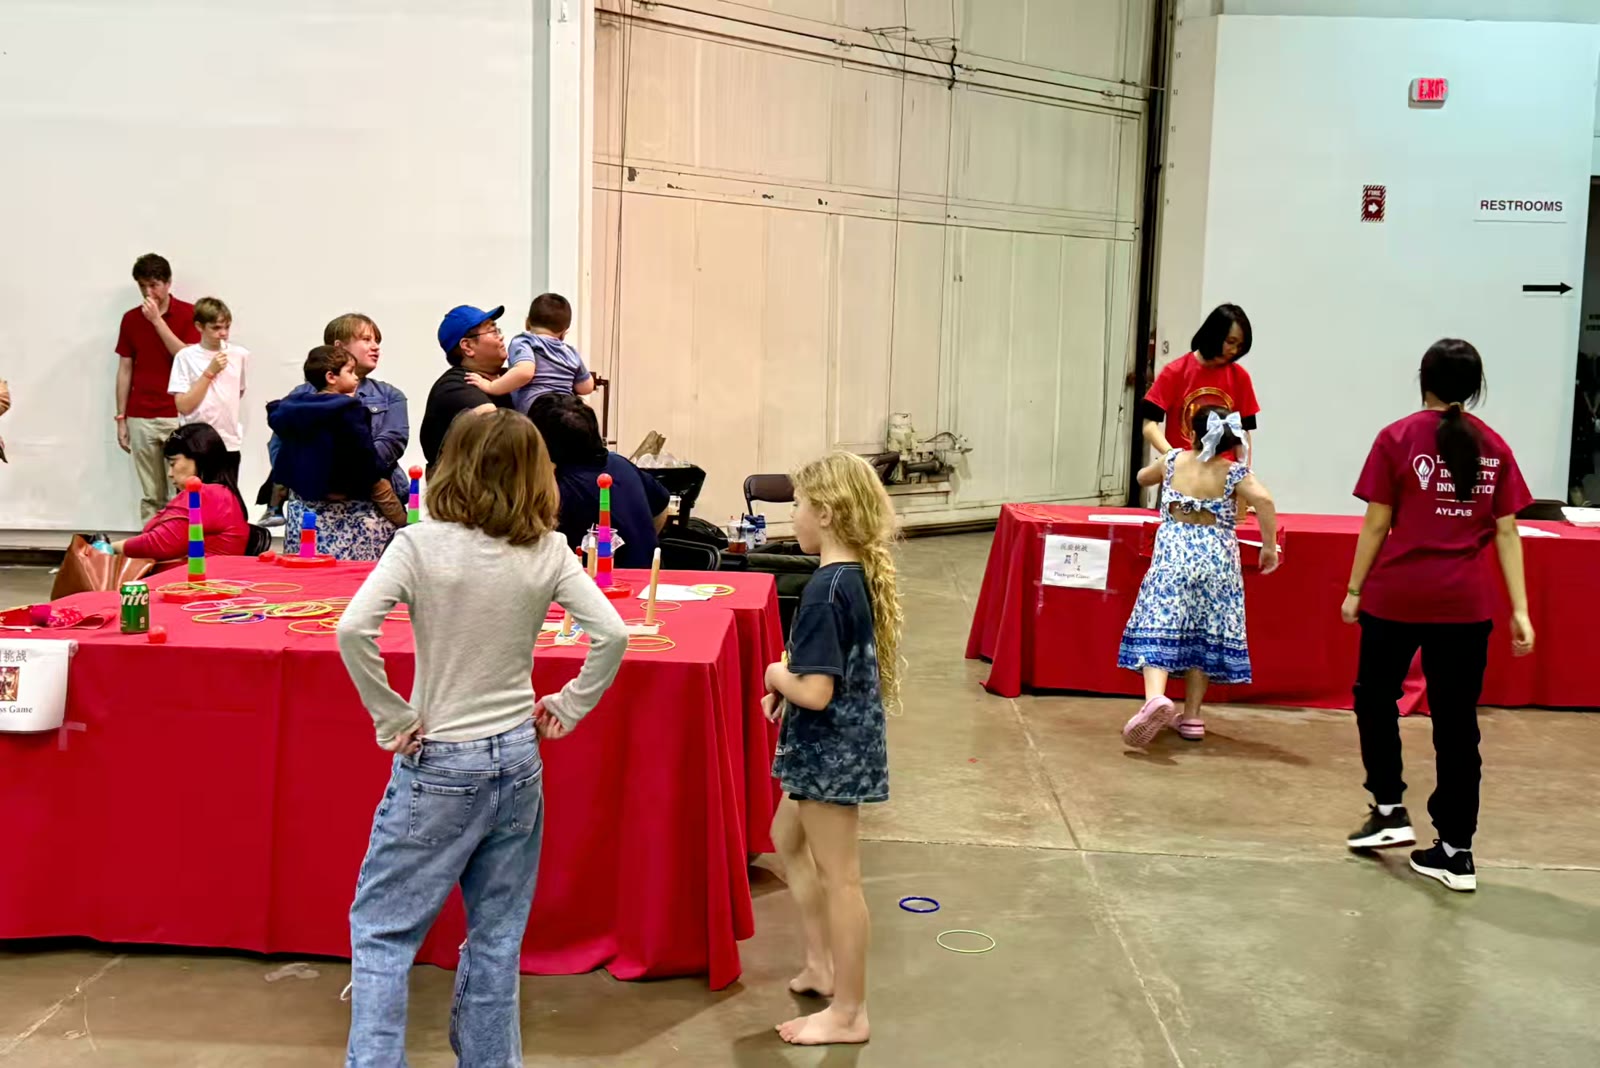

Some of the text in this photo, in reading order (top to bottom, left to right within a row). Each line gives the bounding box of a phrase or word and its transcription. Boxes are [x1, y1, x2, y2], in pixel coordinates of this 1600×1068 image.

[1480, 200, 1563, 212] RESTROOMS
[0, 649, 27, 662] 挑战
[9, 705, 33, 713] Game
